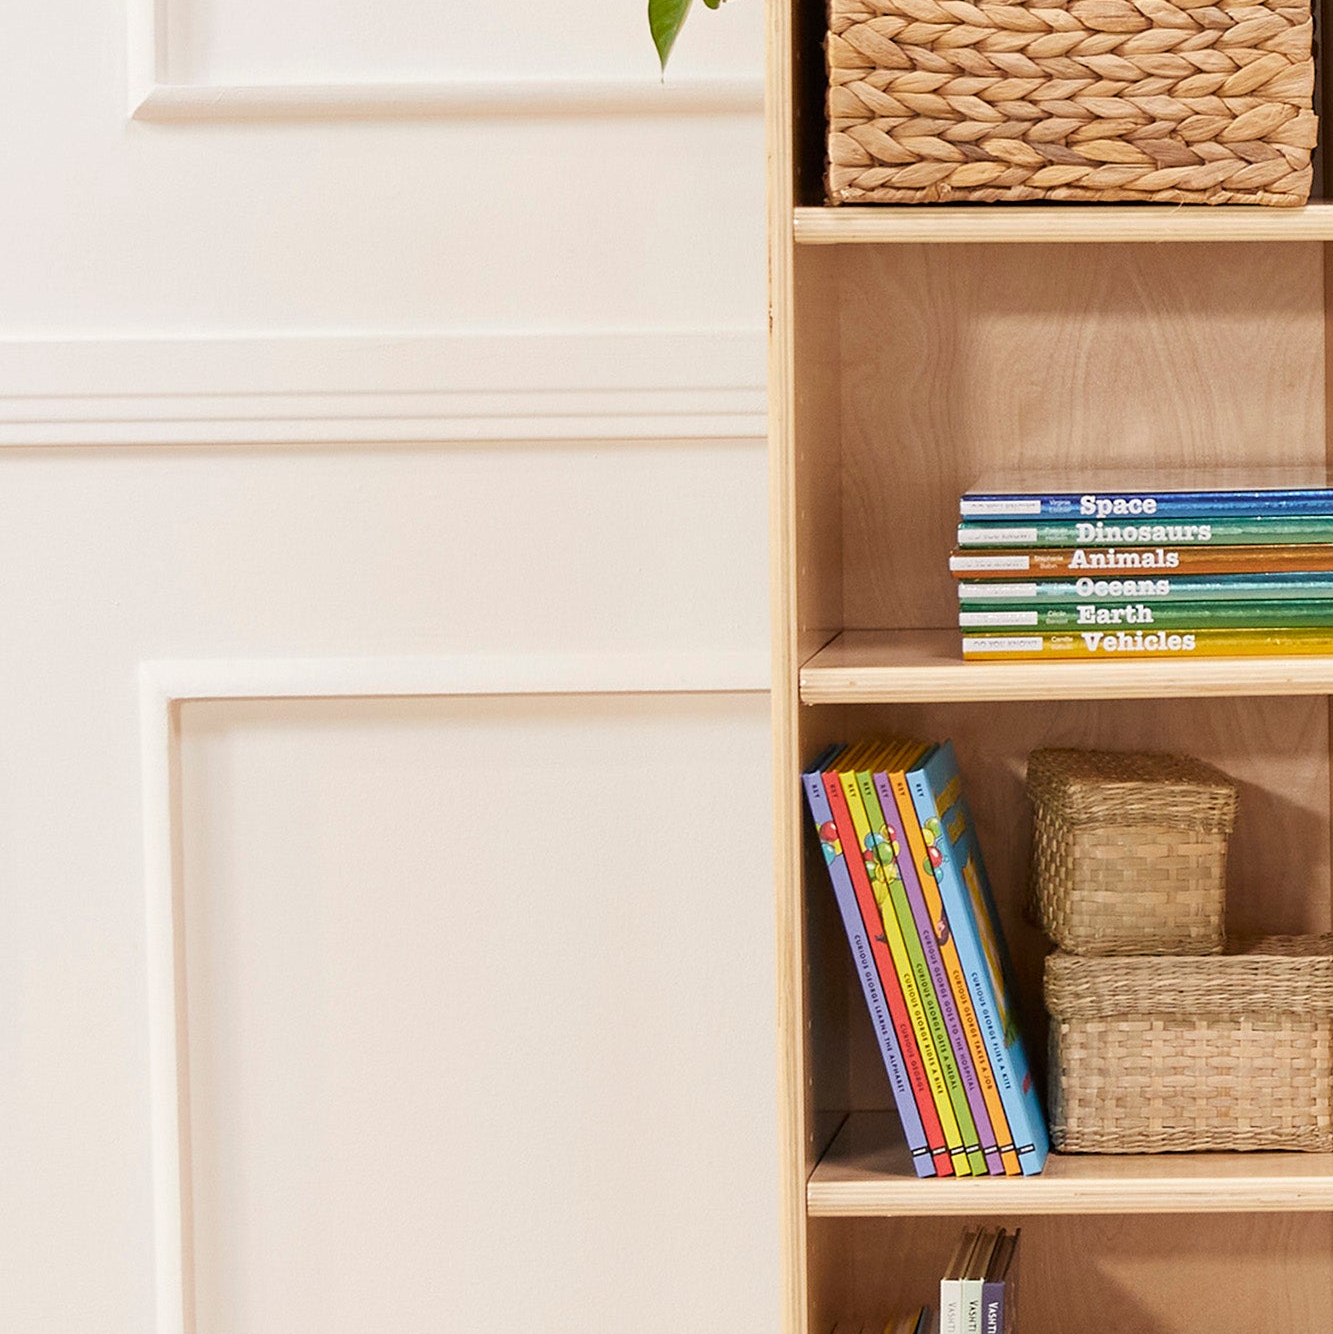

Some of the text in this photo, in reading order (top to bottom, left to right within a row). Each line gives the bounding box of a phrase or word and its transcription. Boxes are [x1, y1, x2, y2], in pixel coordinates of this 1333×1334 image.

[1080, 495, 1157, 517] Space
[1076, 522, 1211, 543] Dinosaurs
[1068, 548, 1178, 568] Animals
[1076, 577, 1170, 596] Oceans
[1077, 605, 1153, 624] Earth
[1081, 631, 1195, 651] Vehicles
[853, 934, 904, 1092] CURIOUS GEORGE LEARNS THE ALPHABET
[970, 971, 986, 1006] CURIOUS
[981, 1009, 996, 1039] GEORGE
[991, 1042, 1002, 1062] FLIES
[1000, 1073, 1010, 1089] KITE
[986, 1302, 998, 1333] VASHTI
